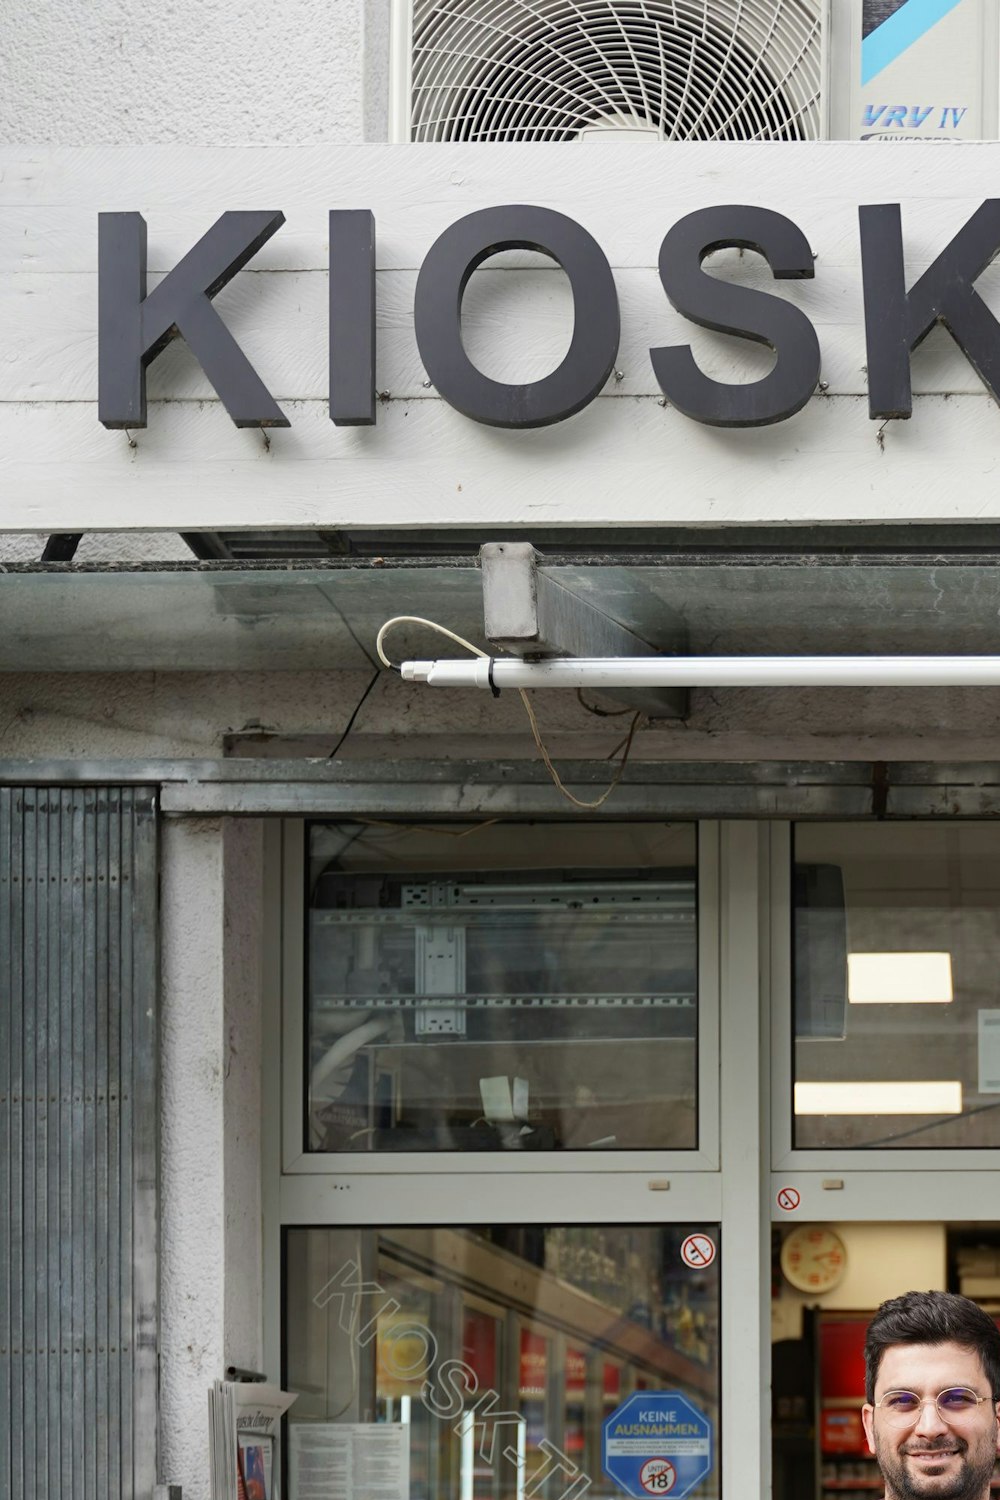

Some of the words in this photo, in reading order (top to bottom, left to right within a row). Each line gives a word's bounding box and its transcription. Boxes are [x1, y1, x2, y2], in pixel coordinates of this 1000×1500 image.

[861, 104, 934, 128] VRV
[938, 107, 968, 128] IV
[639, 1411, 677, 1422] KEINE
[648, 1473, 668, 1488] 18
